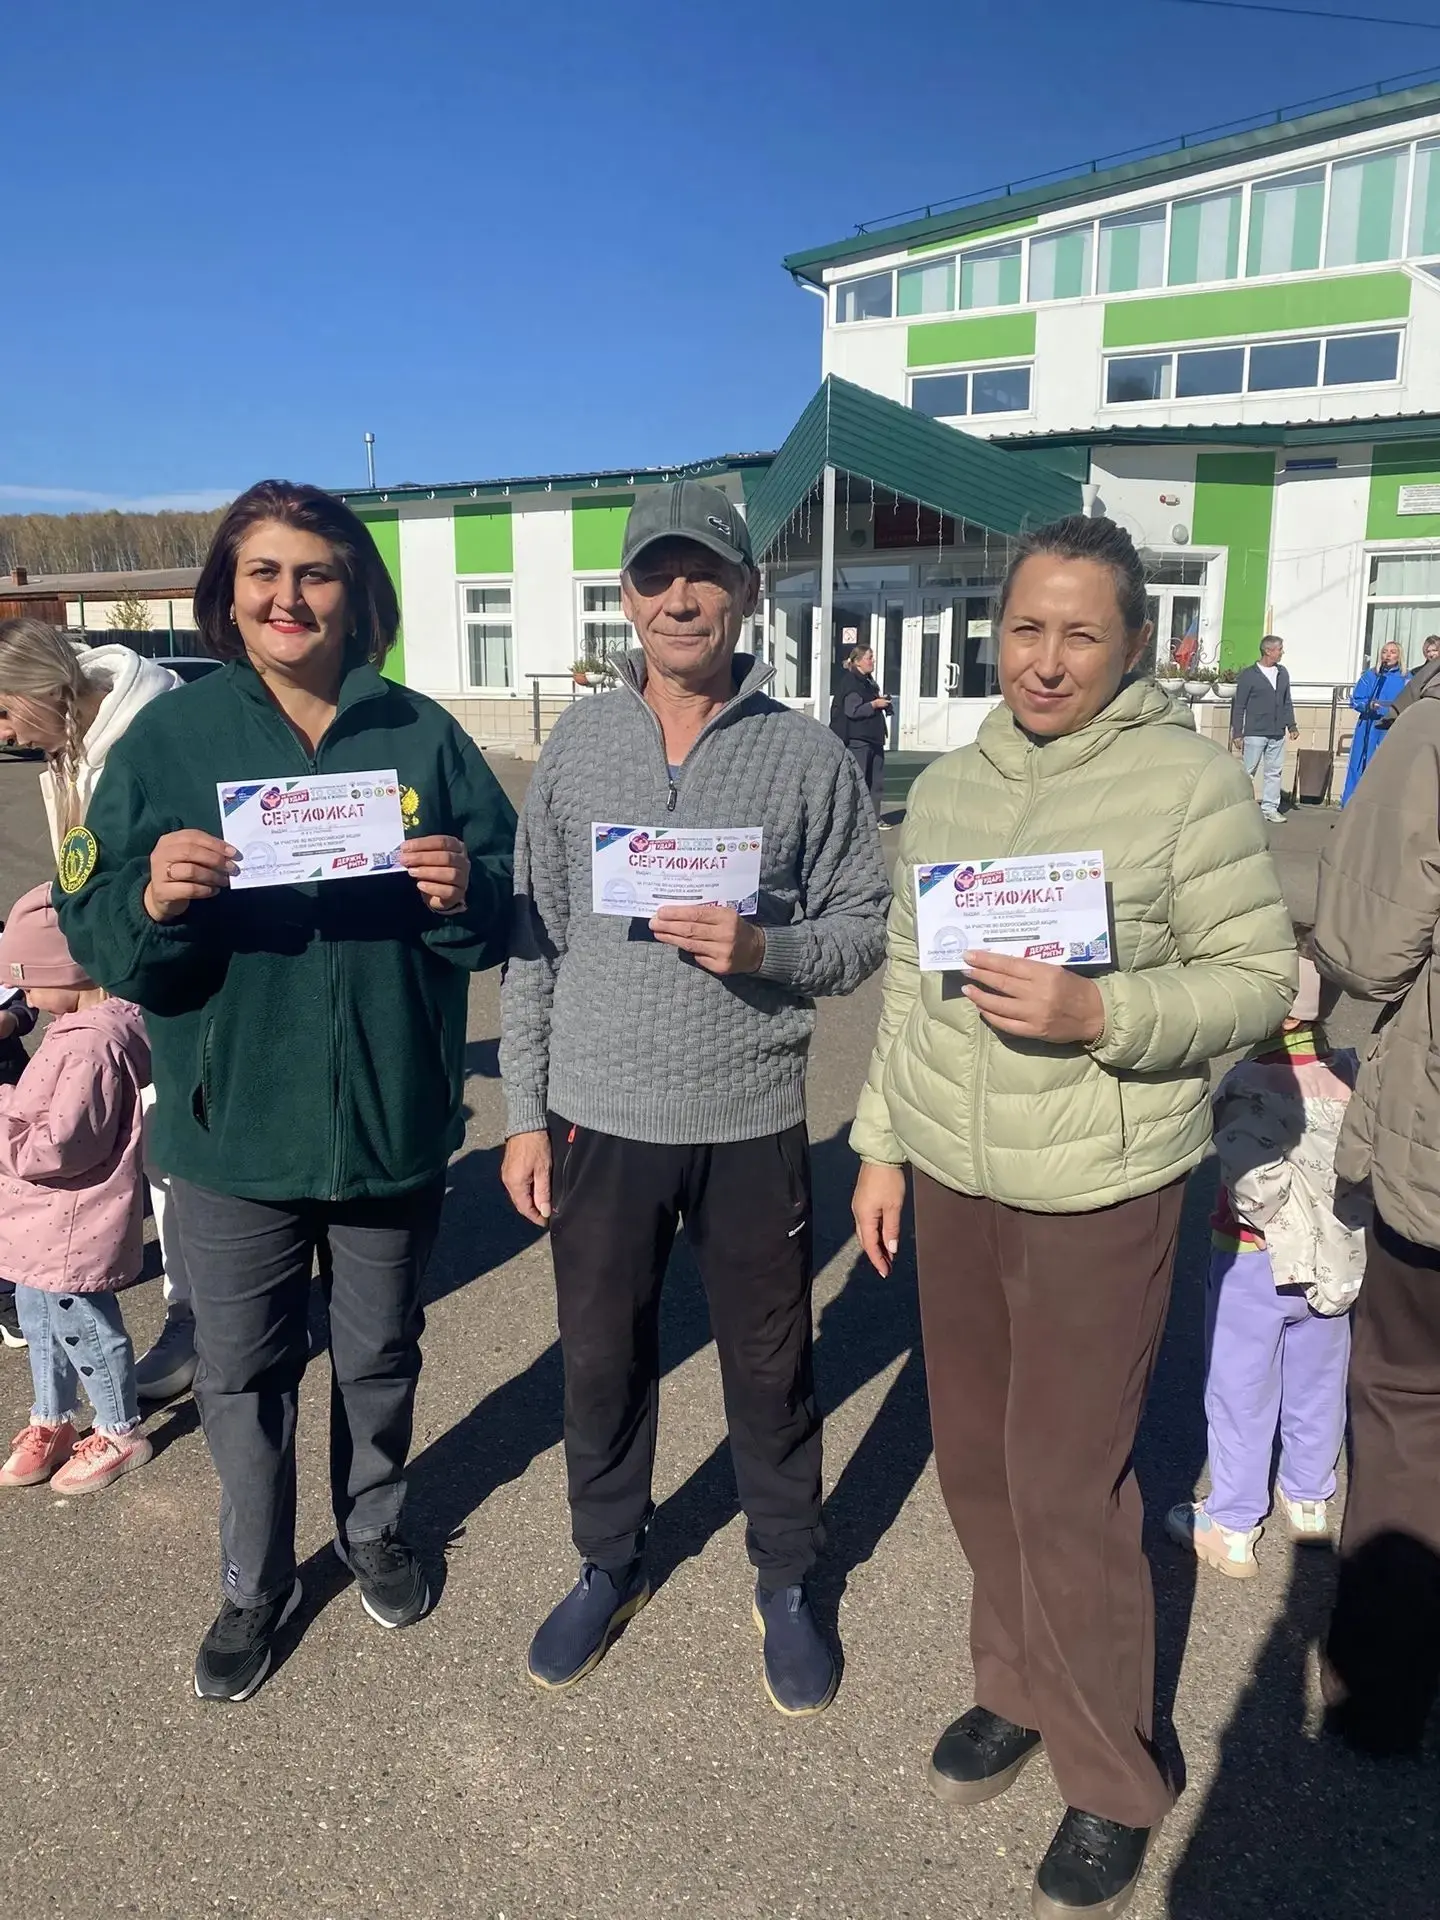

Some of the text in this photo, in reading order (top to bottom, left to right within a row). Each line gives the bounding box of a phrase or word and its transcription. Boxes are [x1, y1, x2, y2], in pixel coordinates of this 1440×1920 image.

[262, 803, 365, 826] СЕРТИФИКАТ
[629, 854, 728, 870] СЕРТИФИКАТ
[955, 887, 1064, 908] СЕРТИФИКАТ
[1029, 943, 1058, 956] ДЕРЖИ
